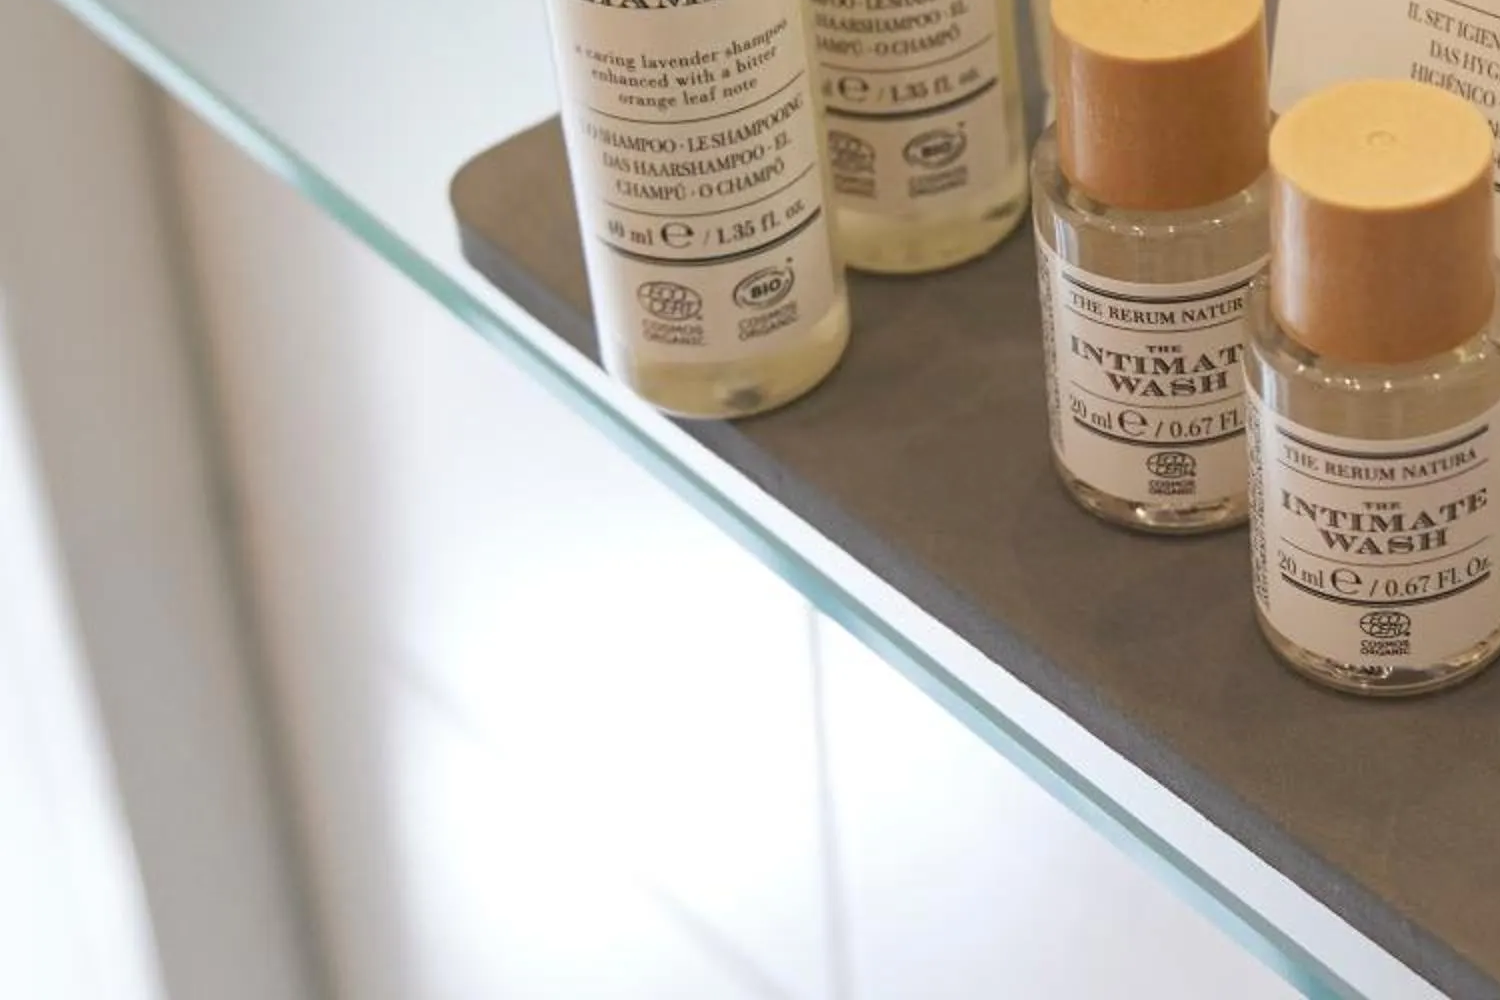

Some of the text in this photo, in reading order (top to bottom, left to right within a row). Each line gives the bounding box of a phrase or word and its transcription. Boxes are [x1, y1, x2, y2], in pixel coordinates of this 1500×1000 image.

[1407, 1, 1422, 24] IL
[1424, 7, 1455, 34] SET
[584, 49, 637, 72] caring
[640, 43, 718, 69] lavender
[724, 18, 788, 57] shampoo
[1430, 39, 1459, 65] DAS
[591, 46, 778, 90] enhanced with a bitter
[618, 76, 758, 113] orange leaf note
[602, 131, 792, 178] DAS HAARSHAMPOO EL
[688, 133, 711, 152] LE
[698, 181, 715, 198] O
[630, 227, 655, 247] ml
[716, 219, 757, 245] 1.35
[750, 275, 782, 299] BIO
[1070, 290, 1103, 315] THE
[1108, 305, 1175, 326] RERUM
[1145, 344, 1182, 354] THE
[1105, 370, 1229, 398] WASH
[1070, 393, 1088, 419] 20
[1091, 412, 1113, 431] ml
[1169, 417, 1215, 438] 0.67
[1284, 444, 1477, 481] THE RERUM NATURA
[1281, 488, 1488, 534] INTIMATE
[1362, 501, 1403, 511] THE
[1319, 527, 1448, 555] WASH
[1279, 551, 1297, 574] 20
[1301, 568, 1324, 589] ml
[1385, 575, 1432, 598] 0.67
